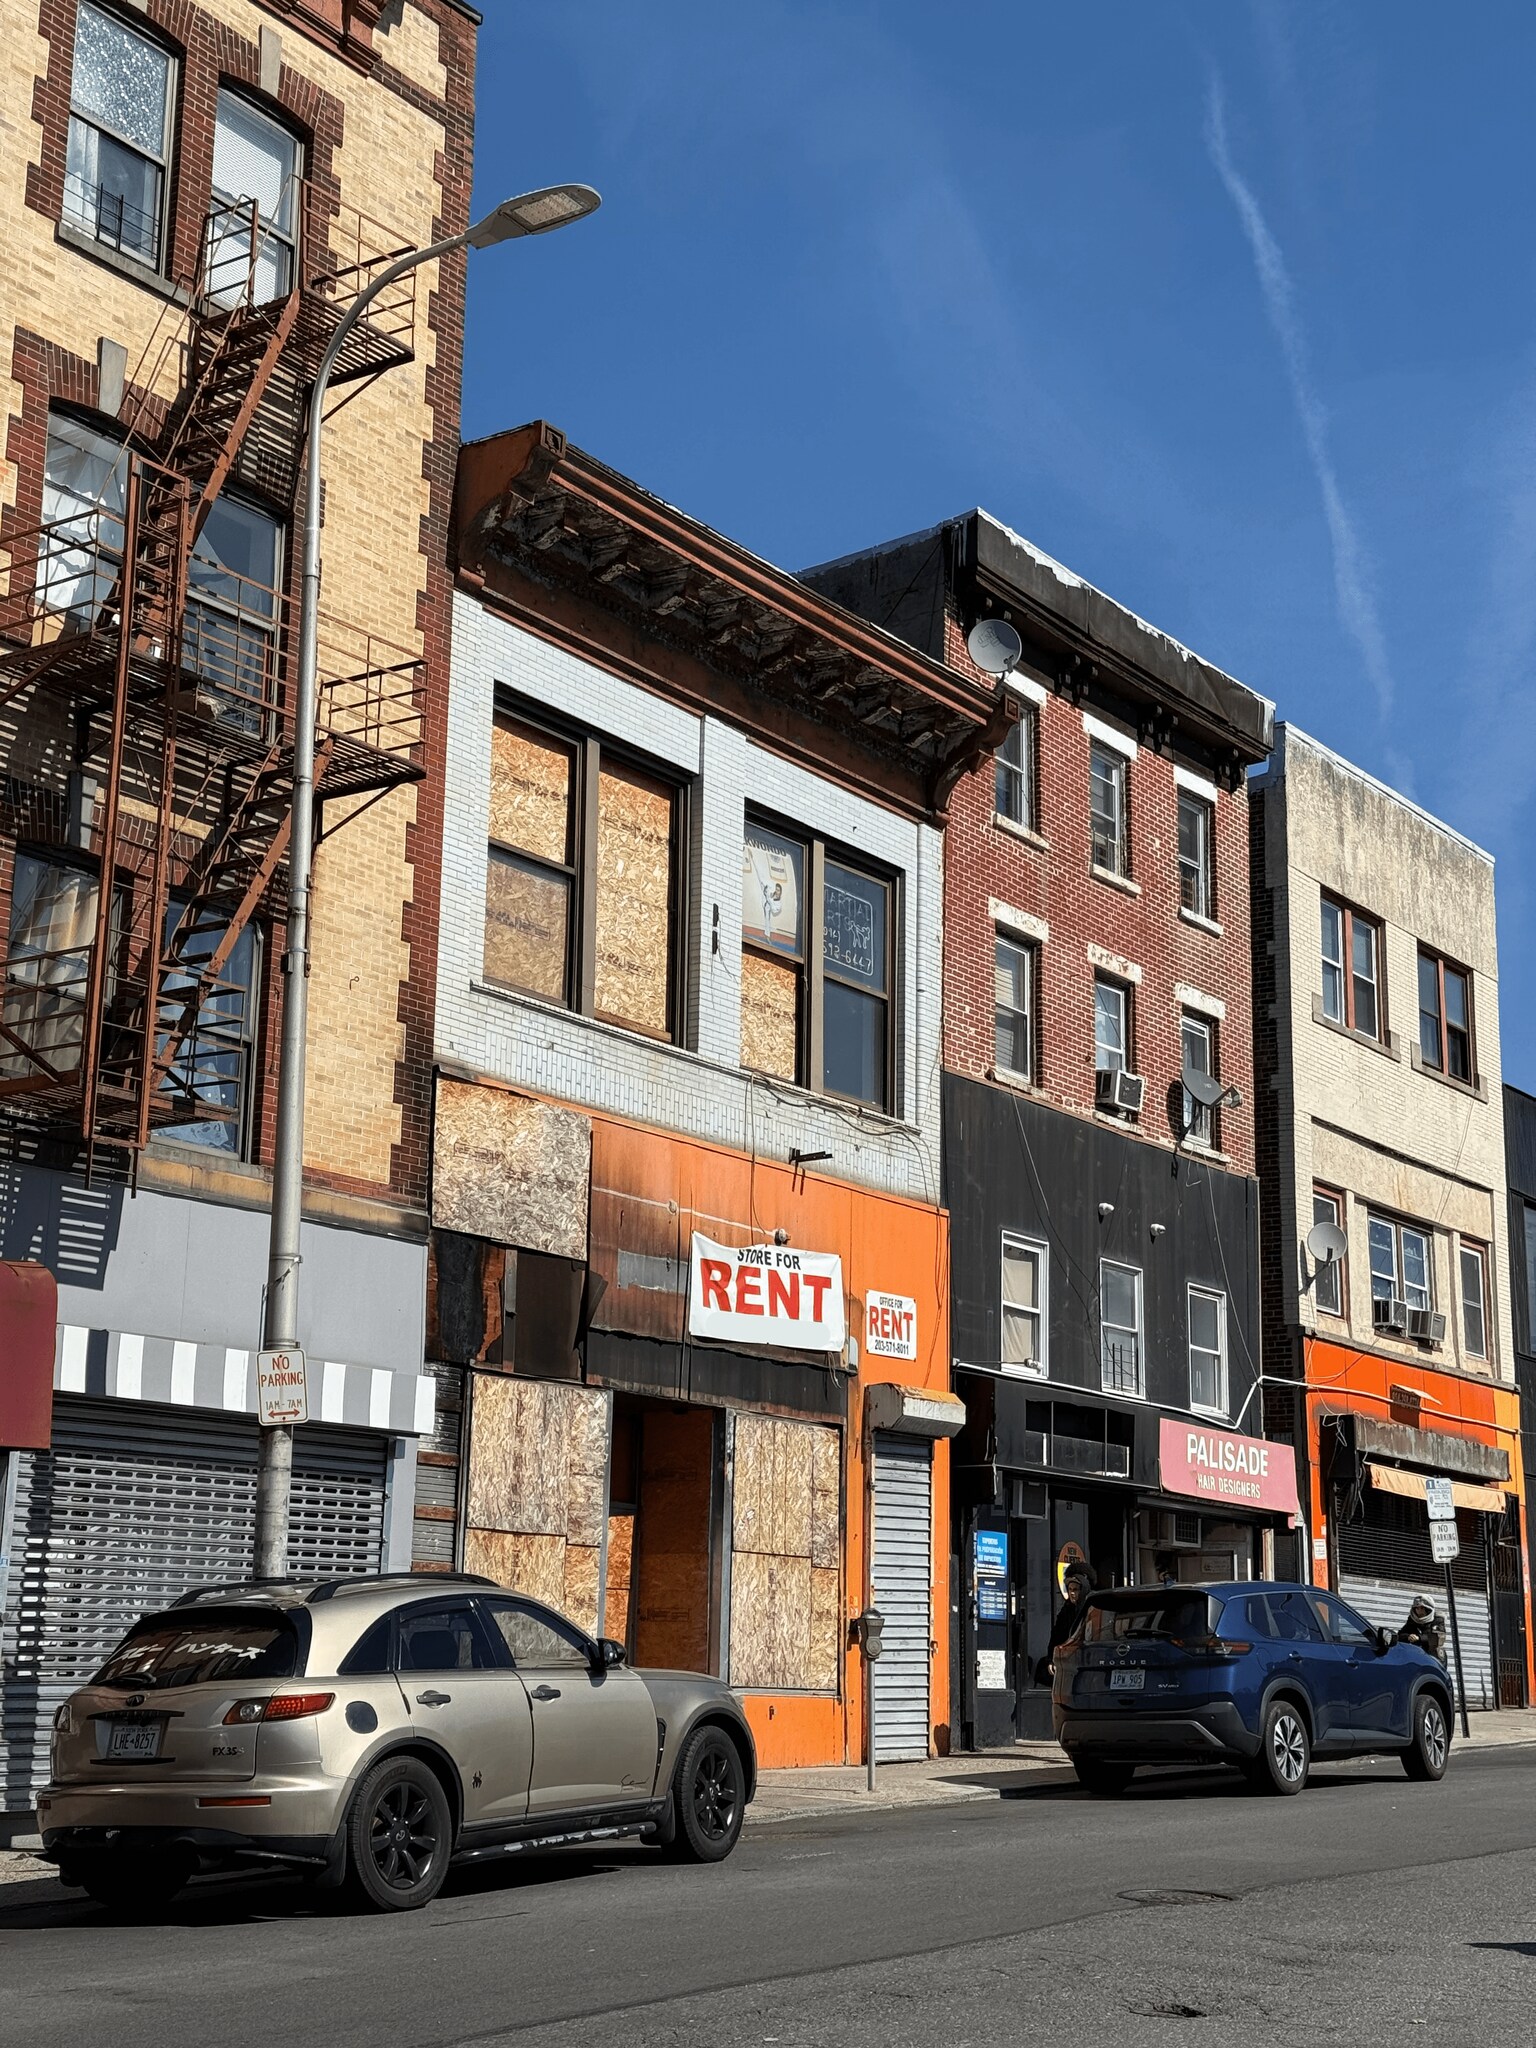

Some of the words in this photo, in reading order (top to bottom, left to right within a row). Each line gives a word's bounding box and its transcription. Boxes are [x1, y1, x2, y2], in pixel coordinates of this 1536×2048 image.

[737, 1248, 772, 1266] STORE
[776, 1252, 801, 1270] FOR
[700, 1258, 832, 1323] RENT
[879, 1296, 894, 1309] OFFICE
[894, 1299, 903, 1309] FOR
[869, 1305, 914, 1342] RENT
[874, 1339, 909, 1356] 203-571-8011
[272, 1357, 290, 1370] NO
[261, 1372, 303, 1387] PARKING
[1187, 1433, 1268, 1477] PALISADE
[1197, 1473, 1216, 1491] HAIR
[1218, 1477, 1261, 1499] DESIGNERS
[1438, 1525, 1449, 1533] NO
